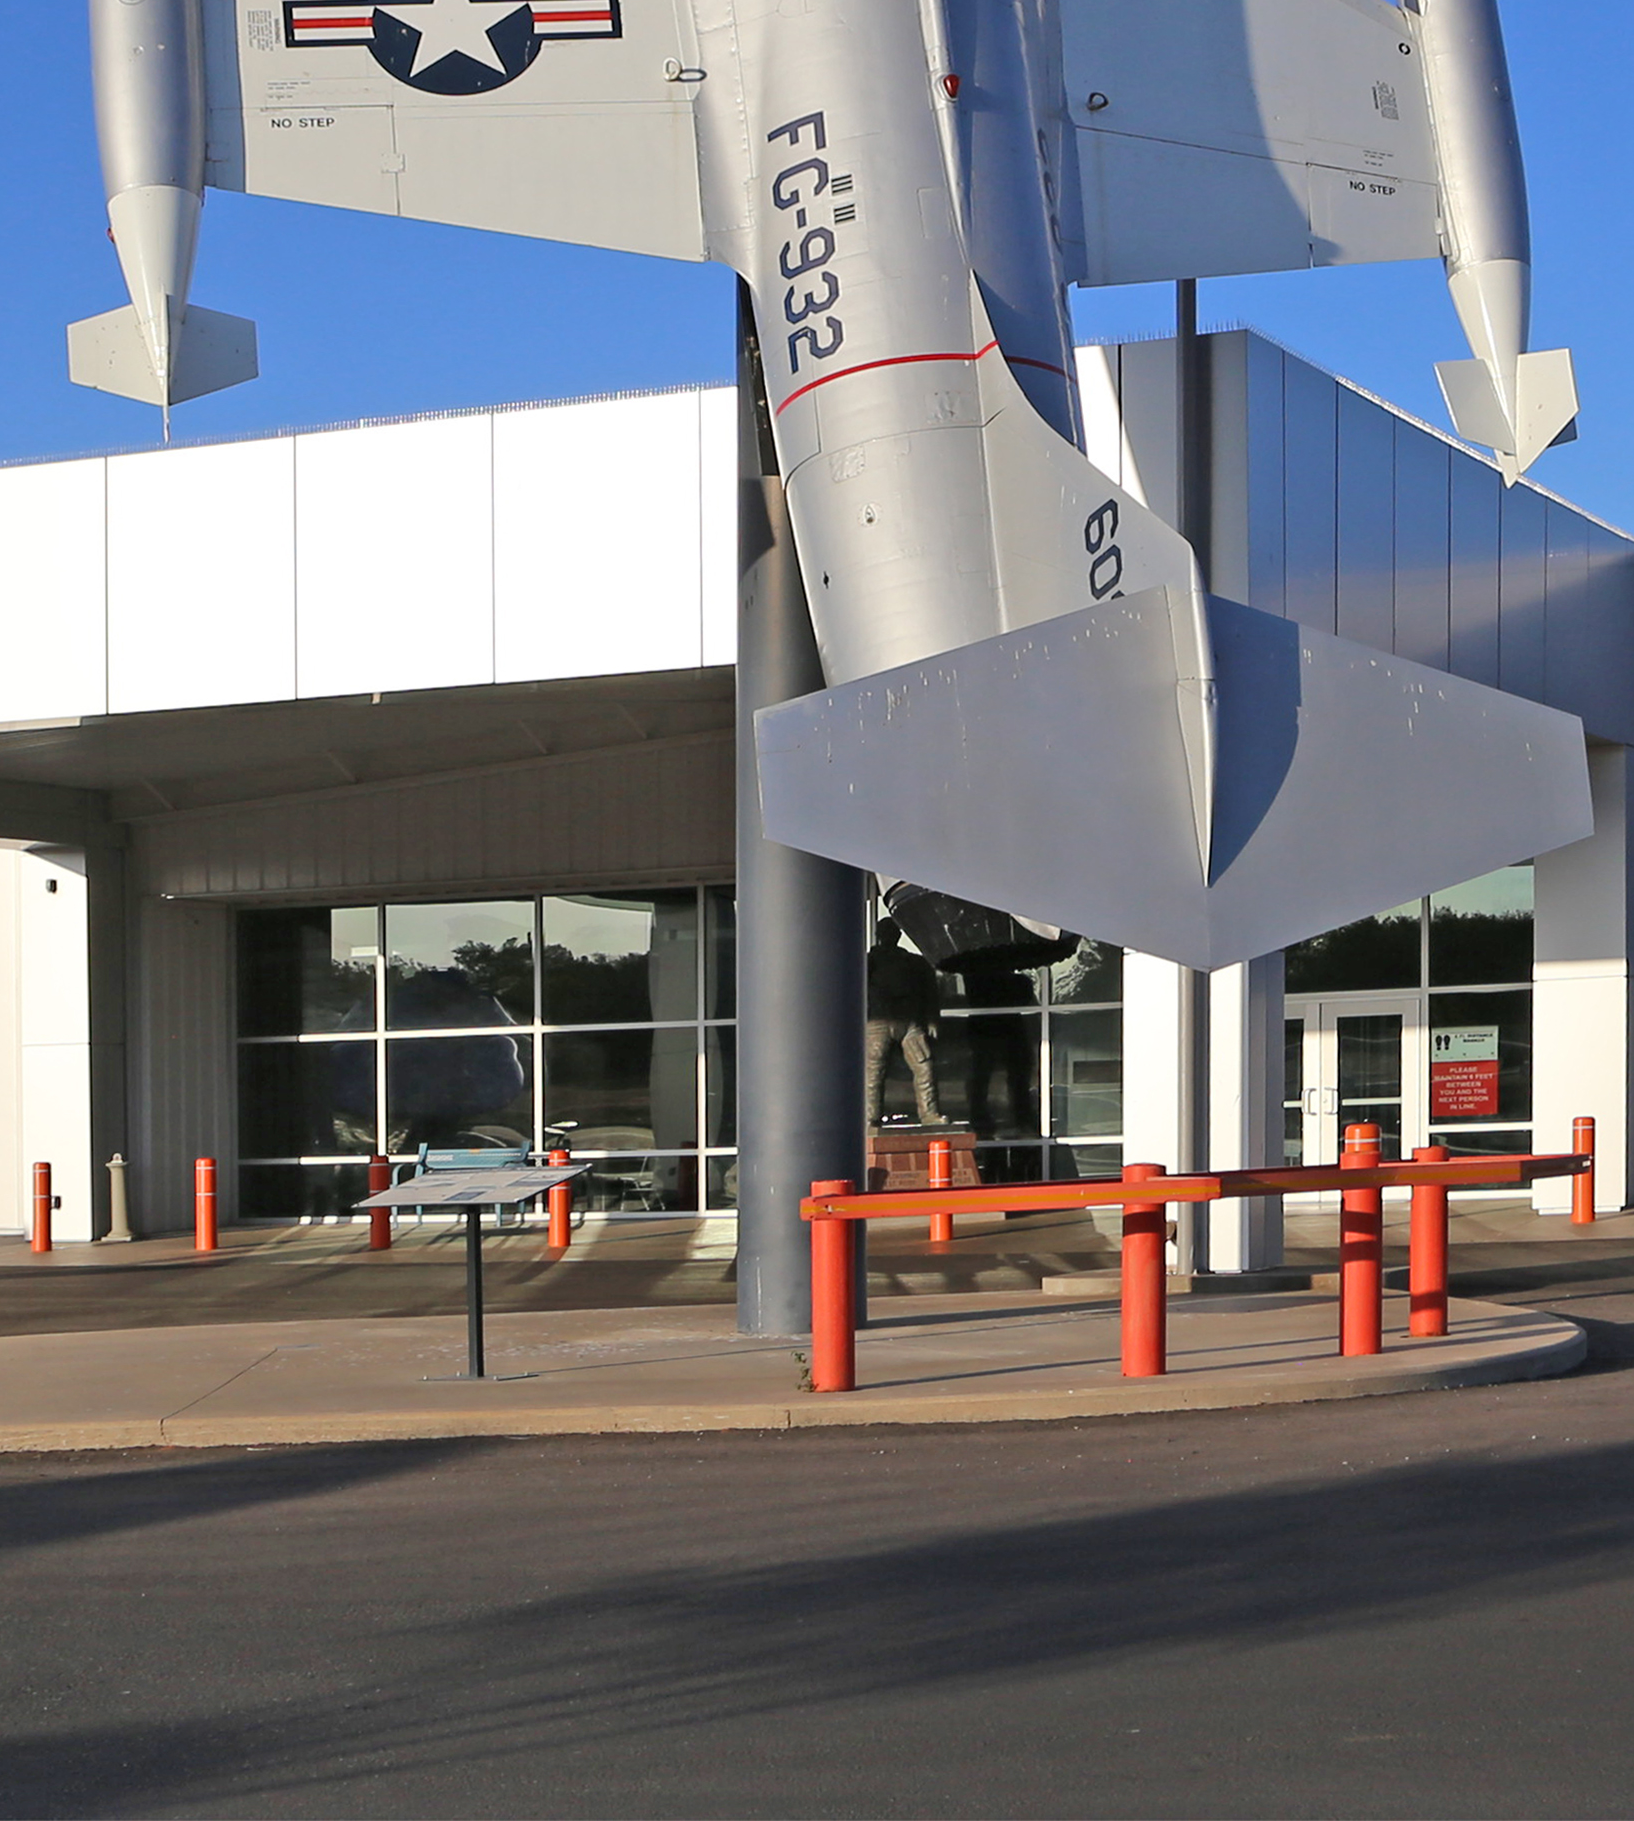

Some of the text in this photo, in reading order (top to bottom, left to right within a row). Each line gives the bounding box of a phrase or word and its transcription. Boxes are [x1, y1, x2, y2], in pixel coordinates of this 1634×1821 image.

[271, 117, 335, 129] NO STEP
[1349, 180, 1396, 196] NO STEP
[767, 110, 844, 375] FG-932
[1084, 498, 1124, 601] 60
